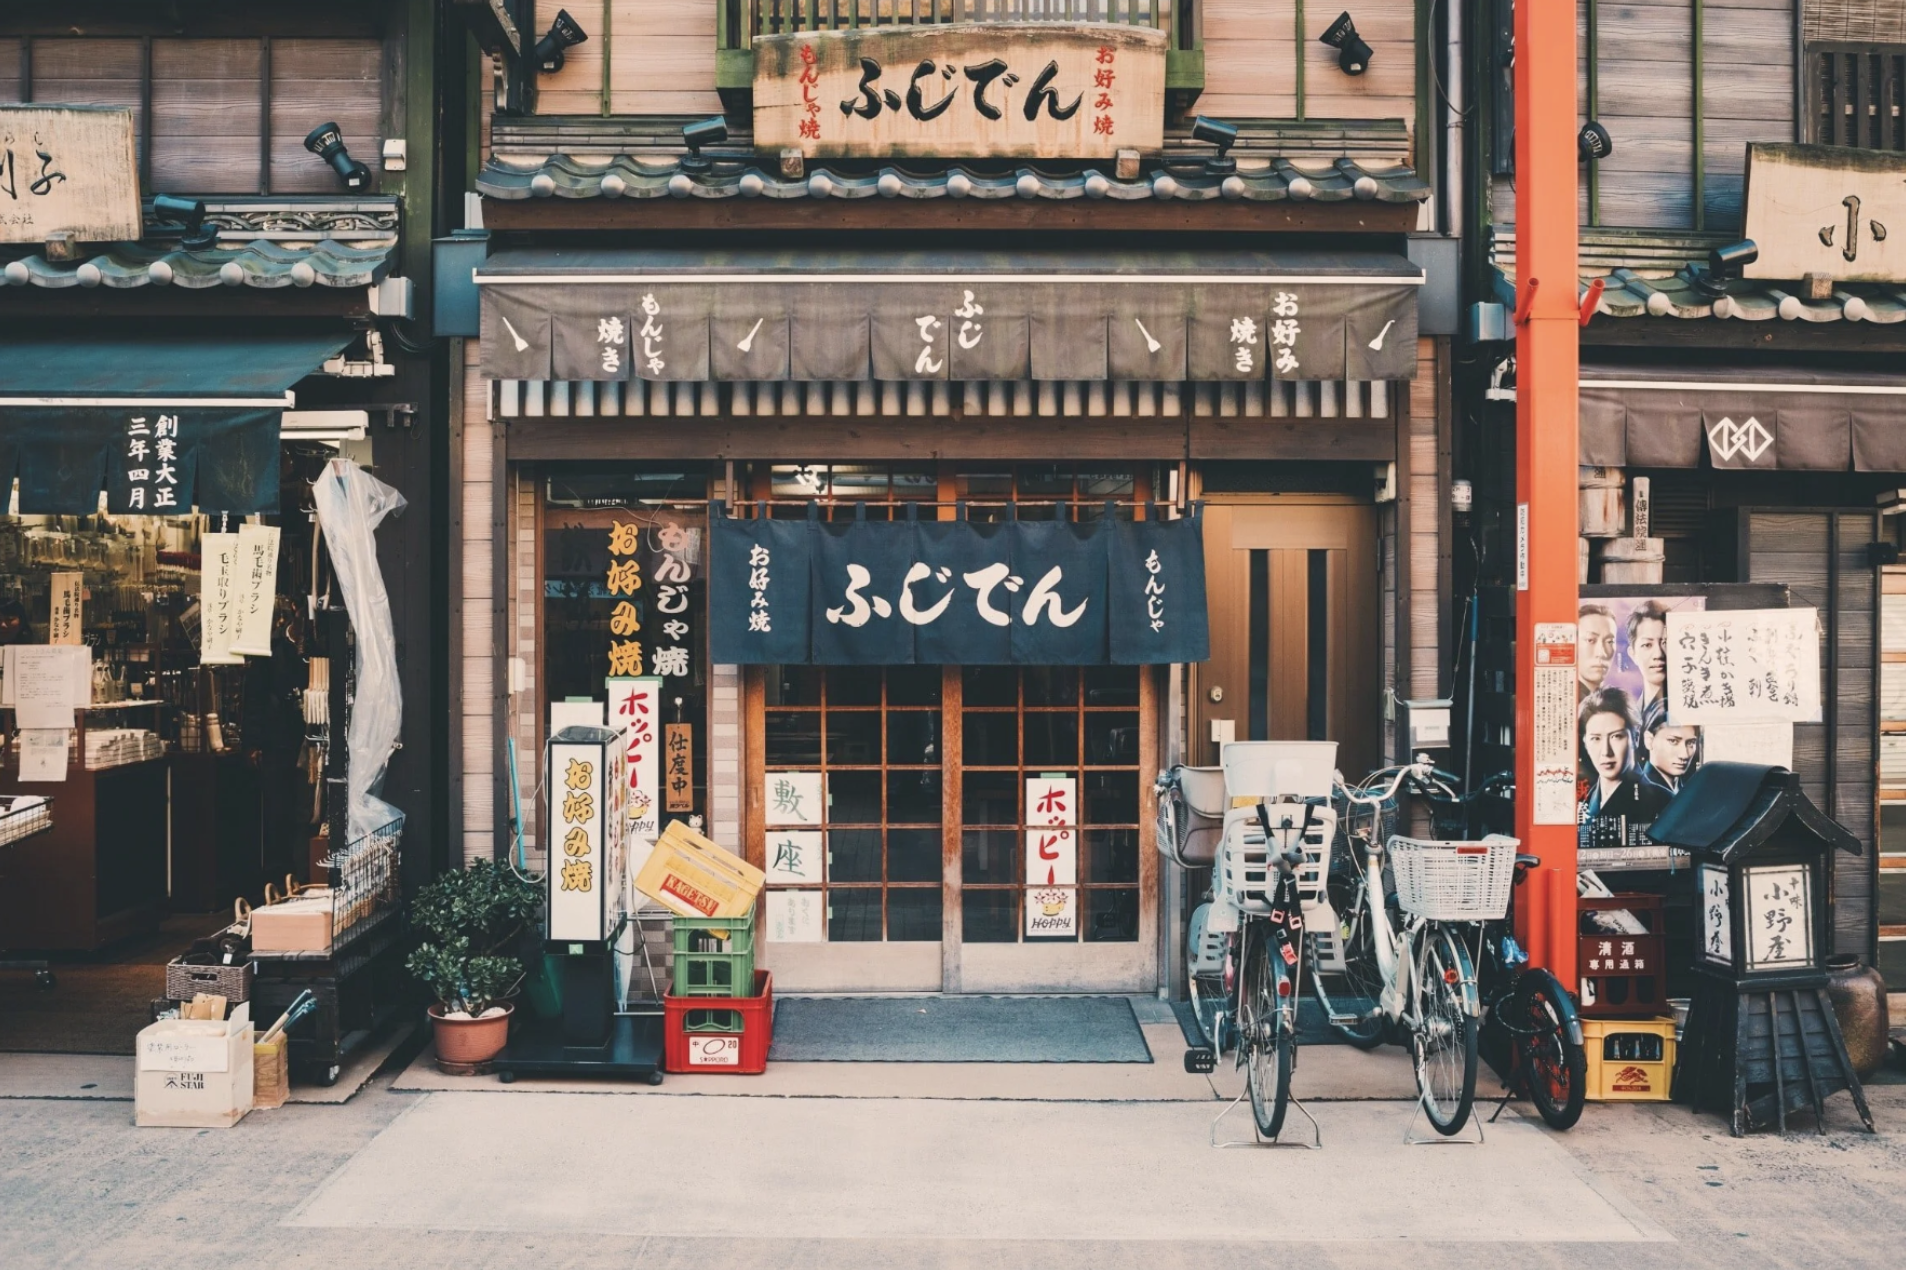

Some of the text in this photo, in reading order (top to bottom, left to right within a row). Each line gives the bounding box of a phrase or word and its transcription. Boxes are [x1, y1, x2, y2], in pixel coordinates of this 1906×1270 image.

[799, 44, 821, 139] もんじゃ焼
[839, 56, 1084, 121] ふじでん
[1093, 45, 1115, 136] お好み焼
[598, 316, 624, 373] 焼き
[640, 293, 665, 375] もんじゃ
[914, 315, 943, 374] でん
[955, 290, 984, 350] ふじ
[1230, 318, 1257, 372] 焼き
[1271, 291, 1301, 374] お好み
[127, 417, 151, 510] 三年四月
[154, 414, 178, 507] 創業大正
[607, 520, 643, 677] お好み焼
[652, 522, 691, 677] もんじゃ焼
[748, 543, 771, 632] お好み焼
[826, 561, 1088, 628] ふじでん
[1144, 548, 1165, 633] もんじゃ
[619, 686, 652, 788] ホッピー
[669, 731, 689, 797] 仕度中
[560, 757, 594, 893] お好み焼
[772, 778, 808, 822] 敷
[1037, 784, 1069, 885] ホッピー
[772, 839, 806, 878] 座
[1598, 941, 1635, 956] 清酒
[1709, 880, 1723, 954] 小野屋
[1762, 882, 1793, 962] 小野屋
[181, 1072, 203, 1081] FUJI
[728, 1040, 737, 1049] 20
[180, 1081, 204, 1090] STAR
